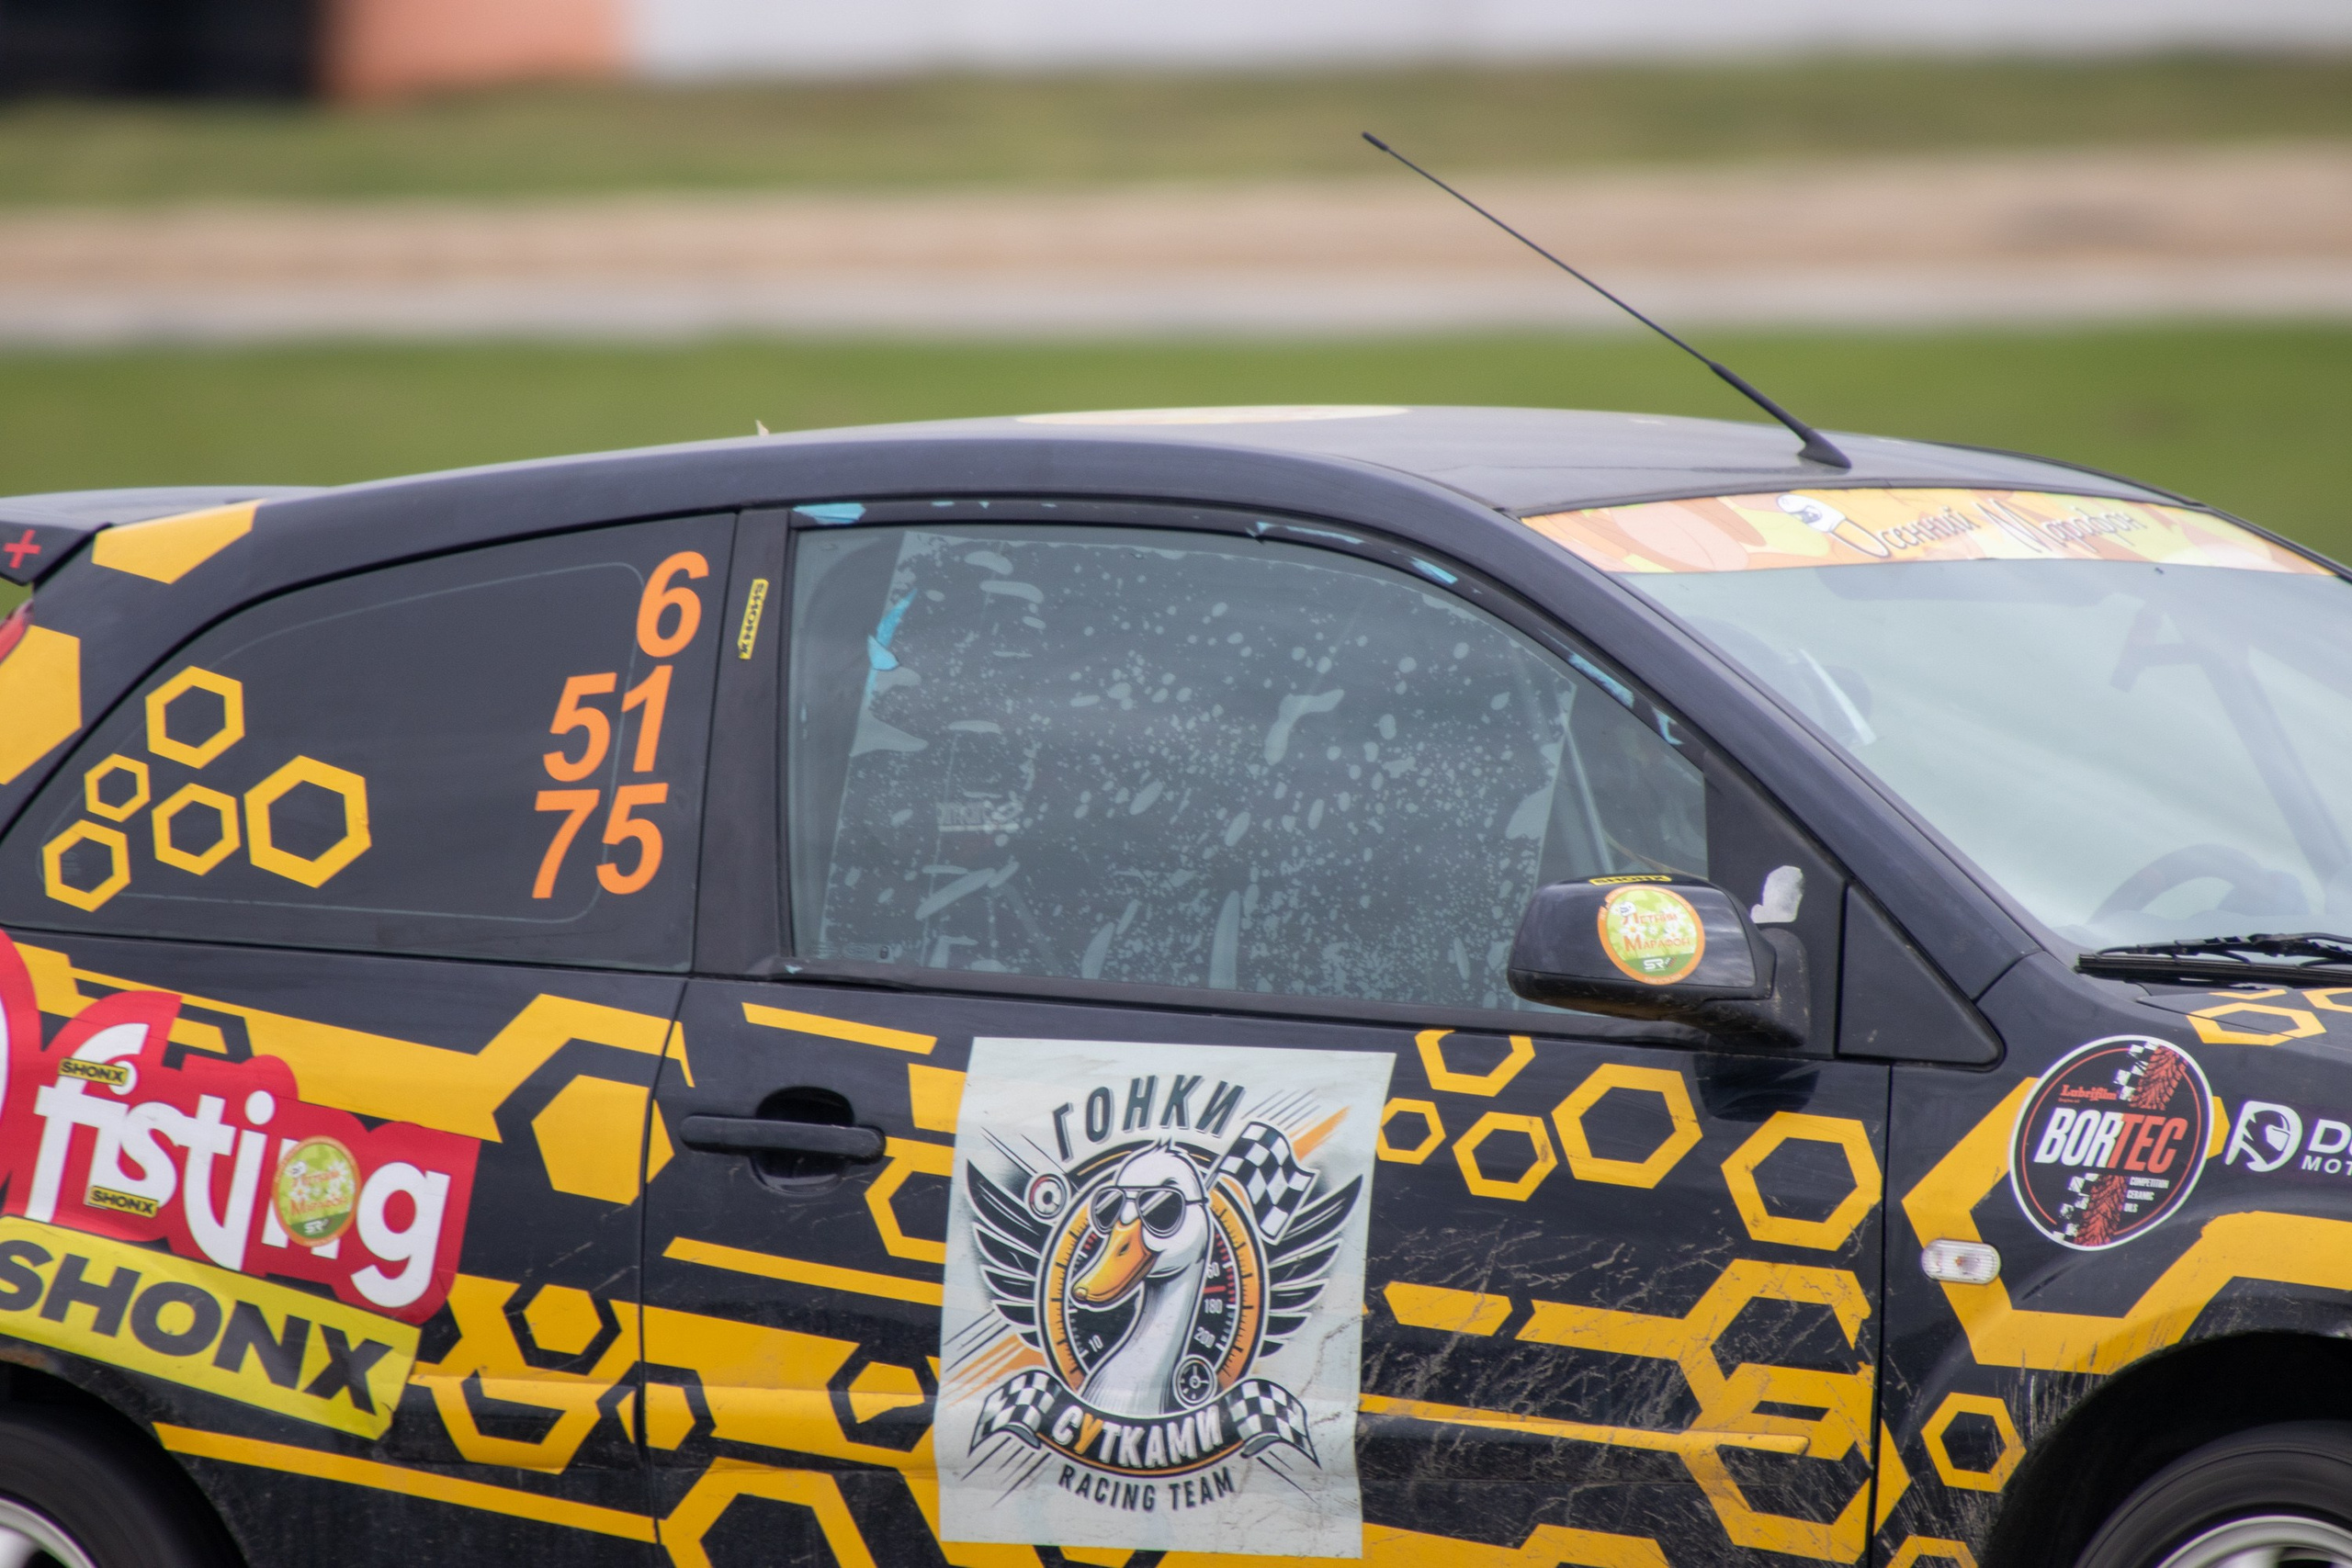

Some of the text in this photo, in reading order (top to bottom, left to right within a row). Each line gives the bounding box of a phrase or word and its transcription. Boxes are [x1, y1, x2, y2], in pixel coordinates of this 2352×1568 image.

[637, 550, 709, 658] 6
[741, 582, 764, 653] SHONX
[543, 664, 673, 782] 51
[532, 783, 669, 898] 75
[61, 1062, 124, 1082] SHONX
[1052, 1074, 1245, 1162] ГОНКИ
[2033, 1107, 2188, 1175] BORTEC
[2308, 1118, 2352, 1155] D
[93, 1189, 153, 1214] SHONX
[0, 1240, 393, 1416] SHONX
[1194, 1326, 1216, 1348] 200
[1204, 1299, 1223, 1314] 180
[1051, 1404, 1224, 1468] СУТКАМИ
[1058, 1464, 1235, 1512] RACING TEAM
